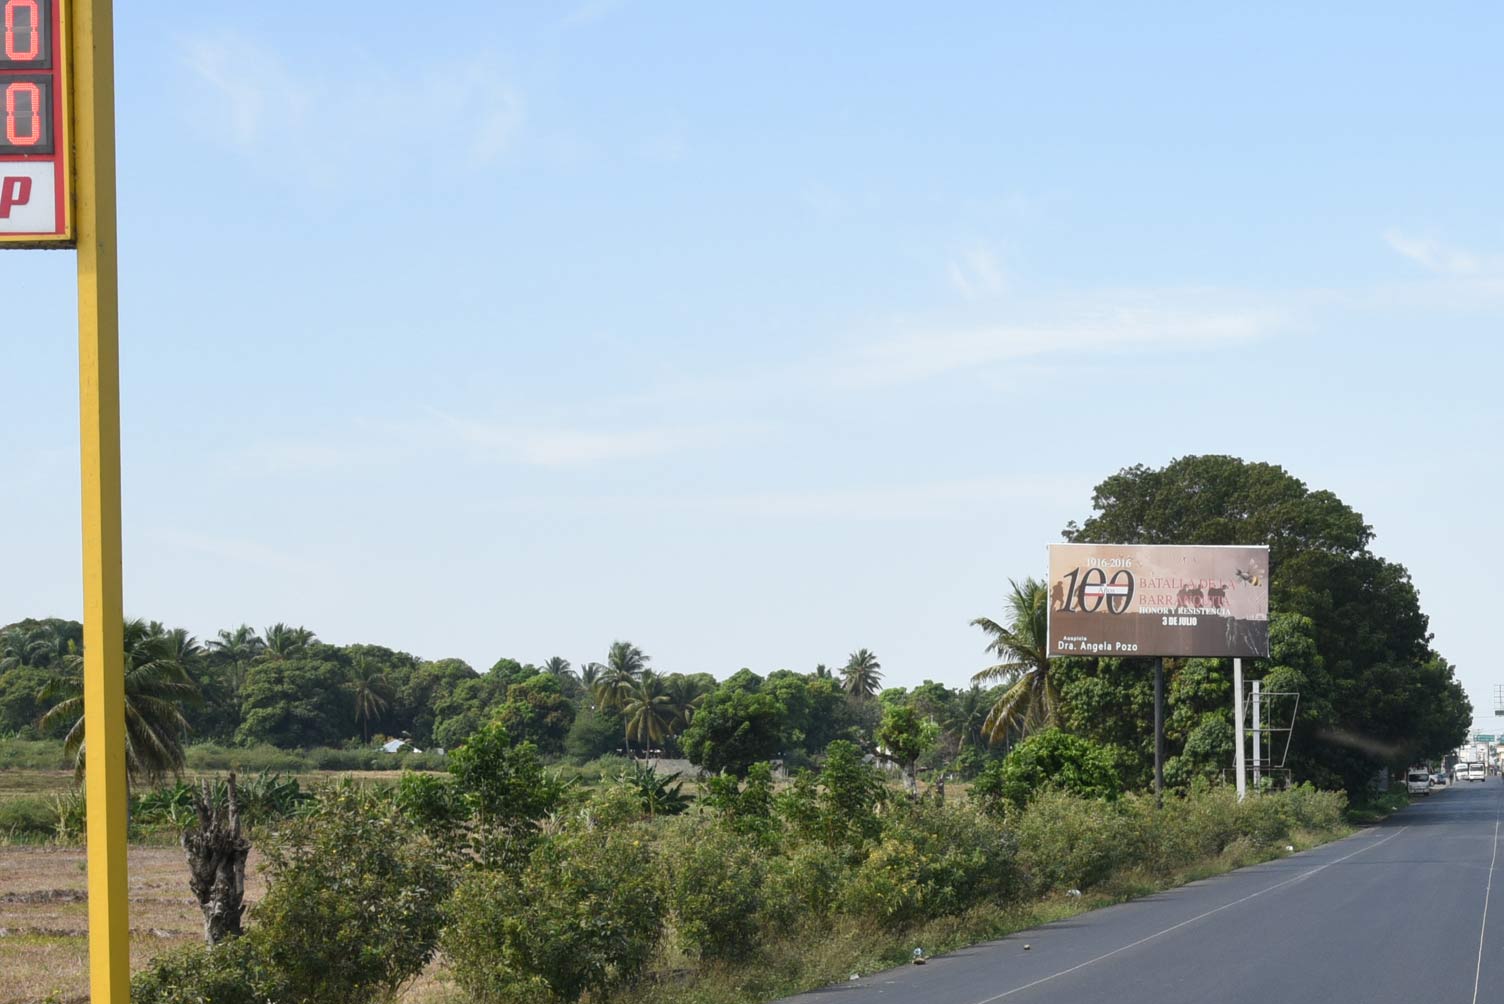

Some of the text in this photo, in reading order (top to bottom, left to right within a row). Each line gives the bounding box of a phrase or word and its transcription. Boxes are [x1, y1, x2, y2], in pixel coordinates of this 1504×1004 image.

[1087, 557, 1132, 568] 1916-2016
[1139, 577, 1195, 589] BATALLA
[1199, 578, 1217, 590] DE
[1056, 567, 1136, 615] 100
[1138, 607, 1169, 615] HONOR
[1177, 607, 1232, 616] RESISTENCIA
[1162, 616, 1198, 626] 3 DE JULIO
[1057, 641, 1138, 653] Dra. Angela Pozo
